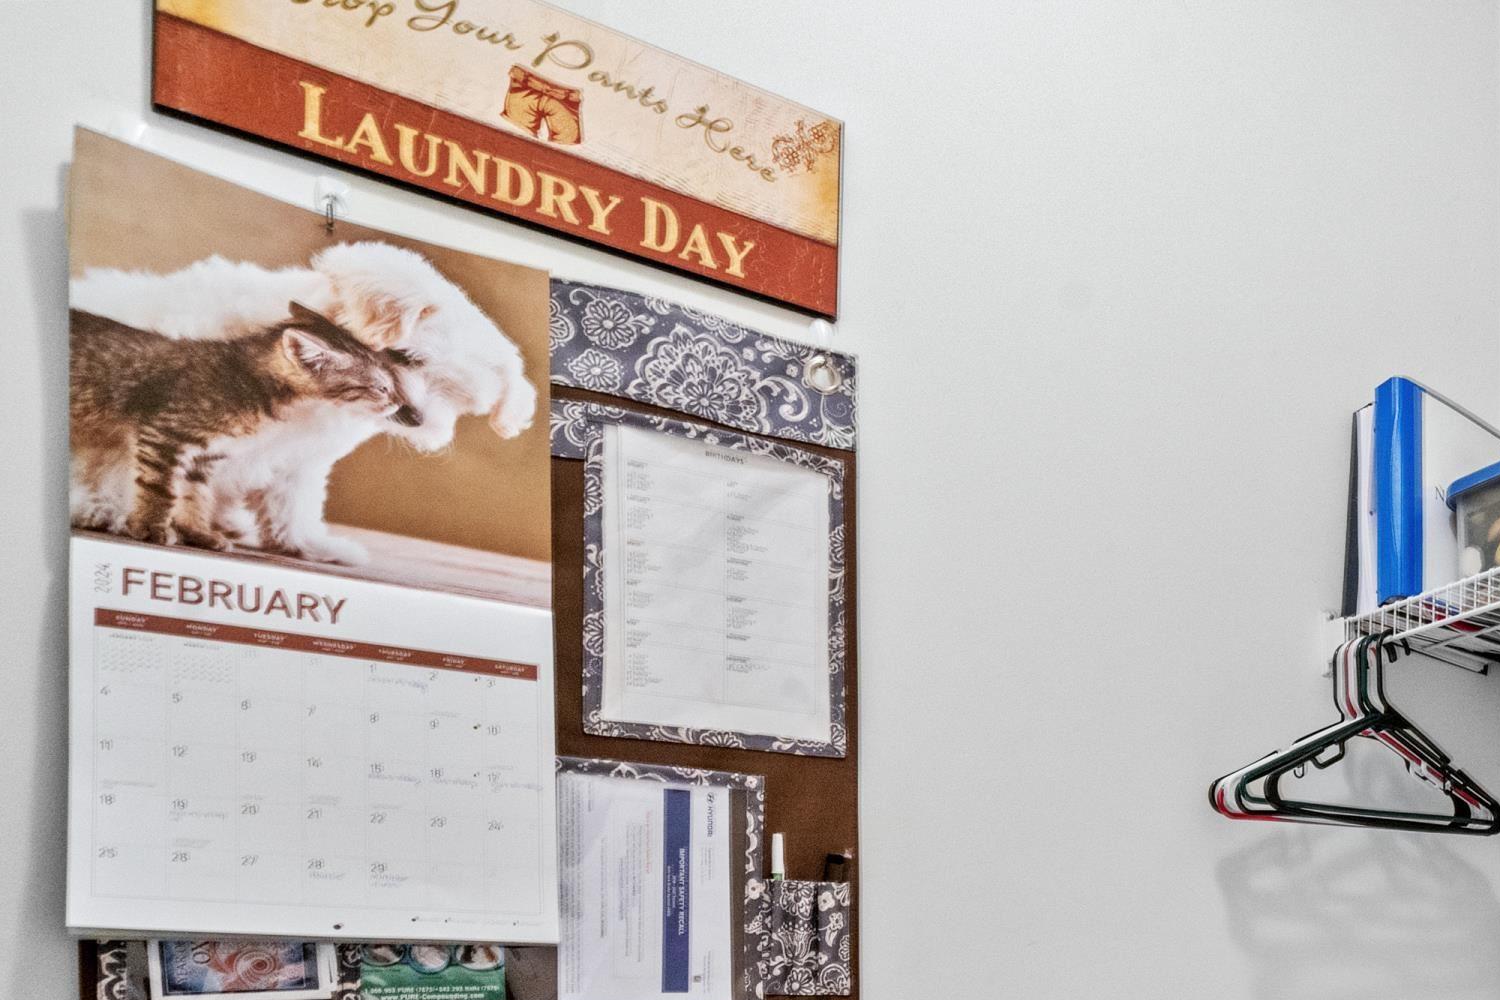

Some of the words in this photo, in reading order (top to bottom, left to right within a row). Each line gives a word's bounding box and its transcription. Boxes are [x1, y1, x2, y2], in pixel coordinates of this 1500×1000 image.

[531, 32, 669, 117] Pants
[675, 104, 778, 183] Here
[298, 80, 621, 235] LAUNDRY
[640, 196, 758, 279] DAY
[705, 450, 744, 464] BIRTHDAYS
[121, 566, 348, 625] FEBRUARY
[115, 614, 147, 624] SUNDAY
[186, 622, 217, 633] MONDAY
[253, 631, 286, 642] TUESDAY
[442, 656, 465, 665] FRIDAY
[678, 848, 686, 885] IMPORTANT
[678, 886, 686, 910] SAFETY
[678, 911, 686, 936] RECALL
